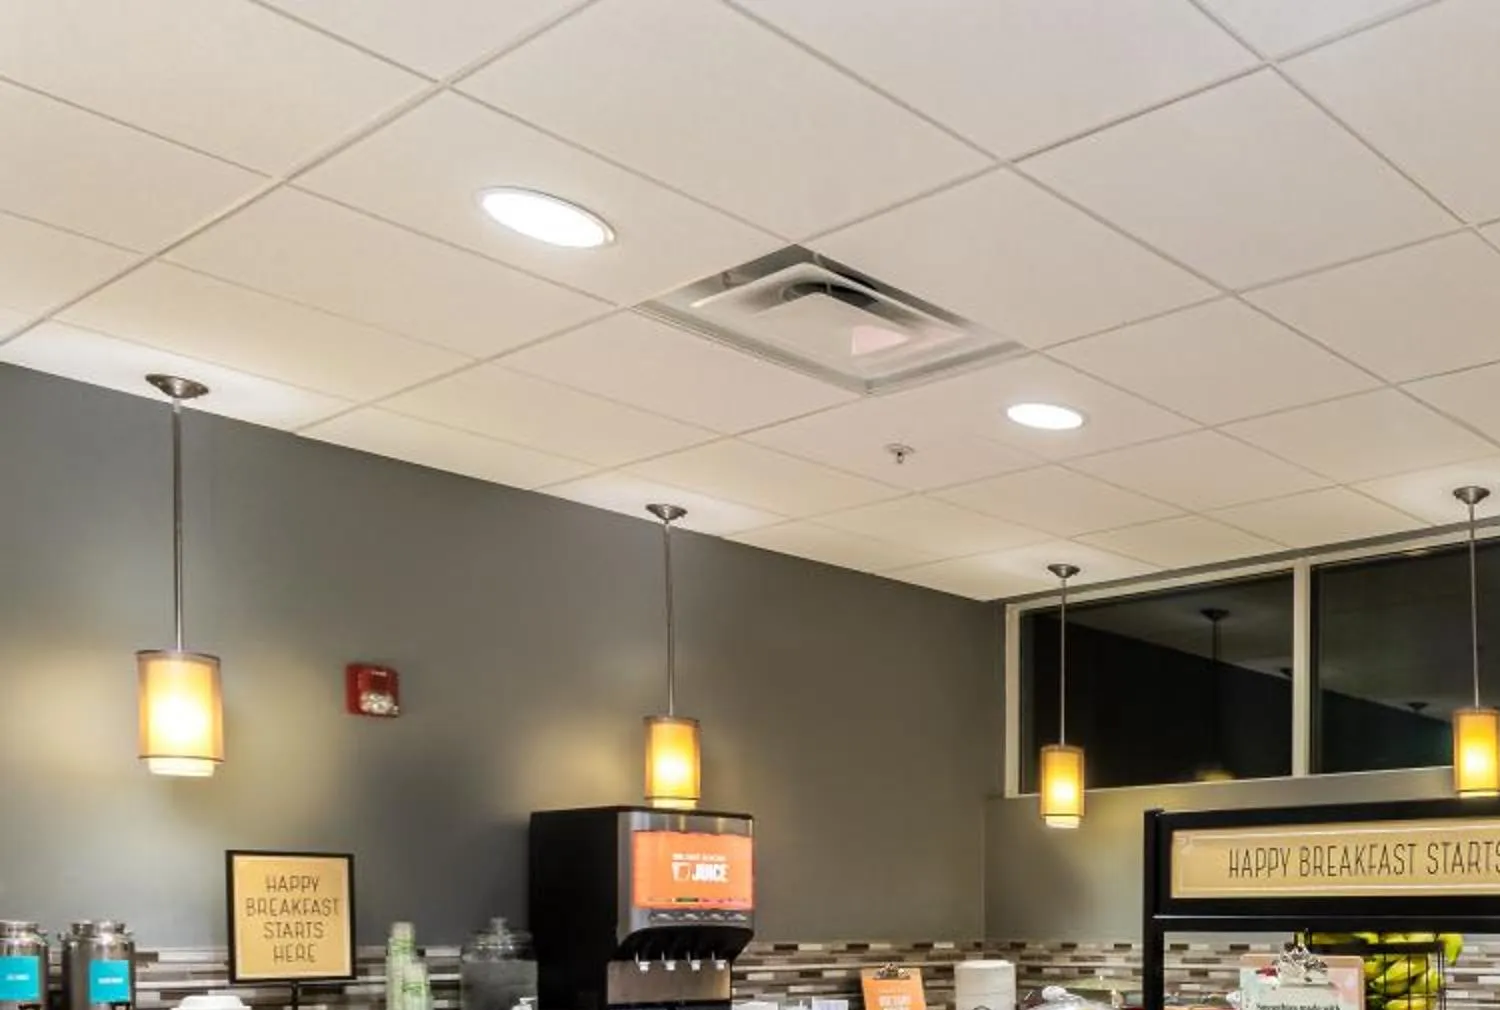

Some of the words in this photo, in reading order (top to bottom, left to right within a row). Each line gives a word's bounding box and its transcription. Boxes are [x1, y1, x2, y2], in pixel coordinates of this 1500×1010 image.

[1228, 847, 1291, 879] HAPPY
[1299, 843, 1418, 877] BREAKFAST
[691, 863, 729, 883] JUICE
[266, 875, 319, 892] HAPPY
[245, 897, 340, 917] BREAKFAST
[263, 921, 325, 939] STARTS
[273, 943, 317, 963] HERE
